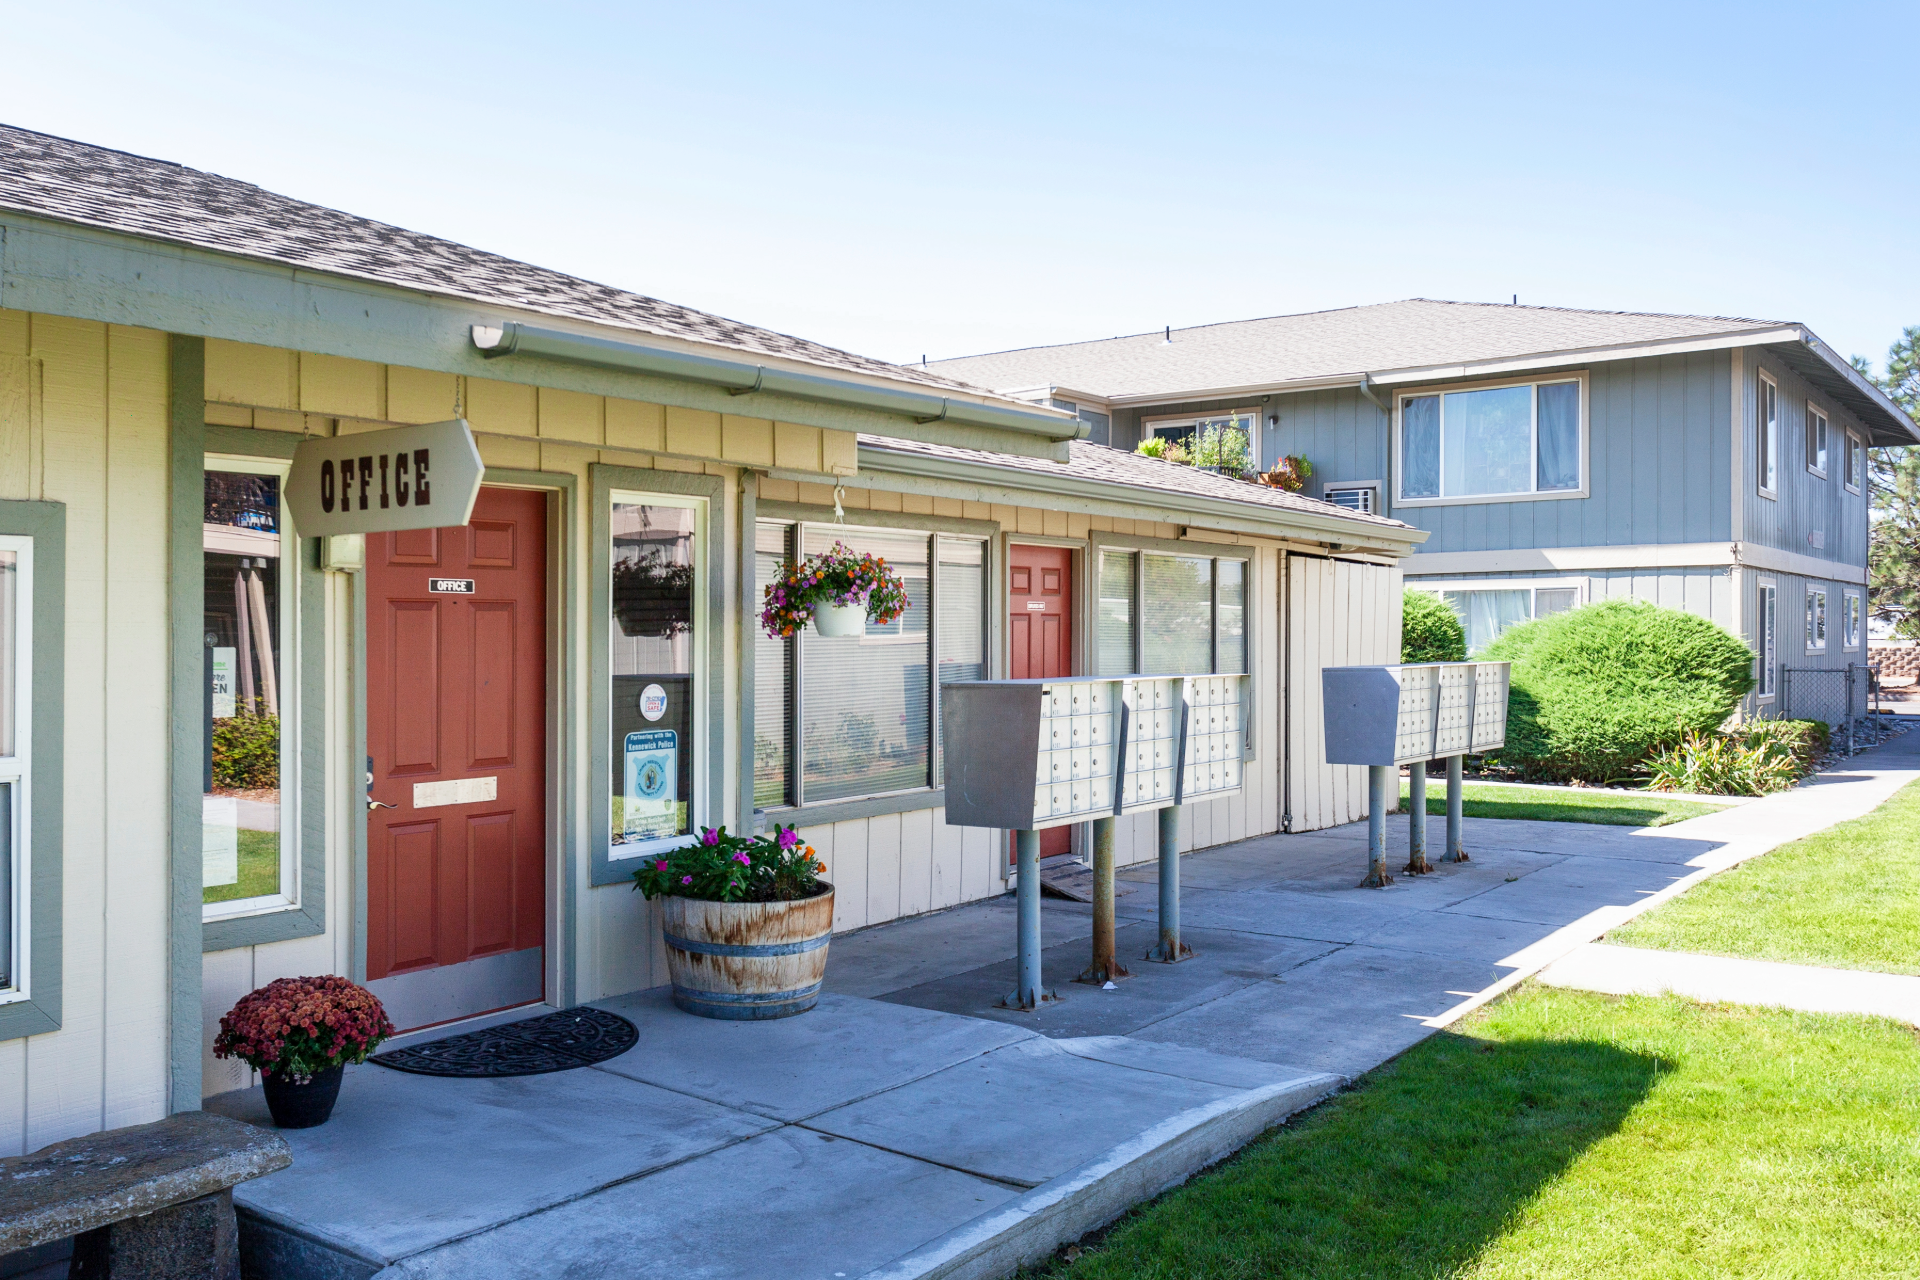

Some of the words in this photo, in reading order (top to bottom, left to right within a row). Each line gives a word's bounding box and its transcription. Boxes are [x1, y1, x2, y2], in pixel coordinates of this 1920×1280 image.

[321, 449, 431, 513] OFFICE
[437, 580, 467, 591] OFFICE
[628, 742, 656, 751] Kennewick
[658, 740, 674, 749] Police
